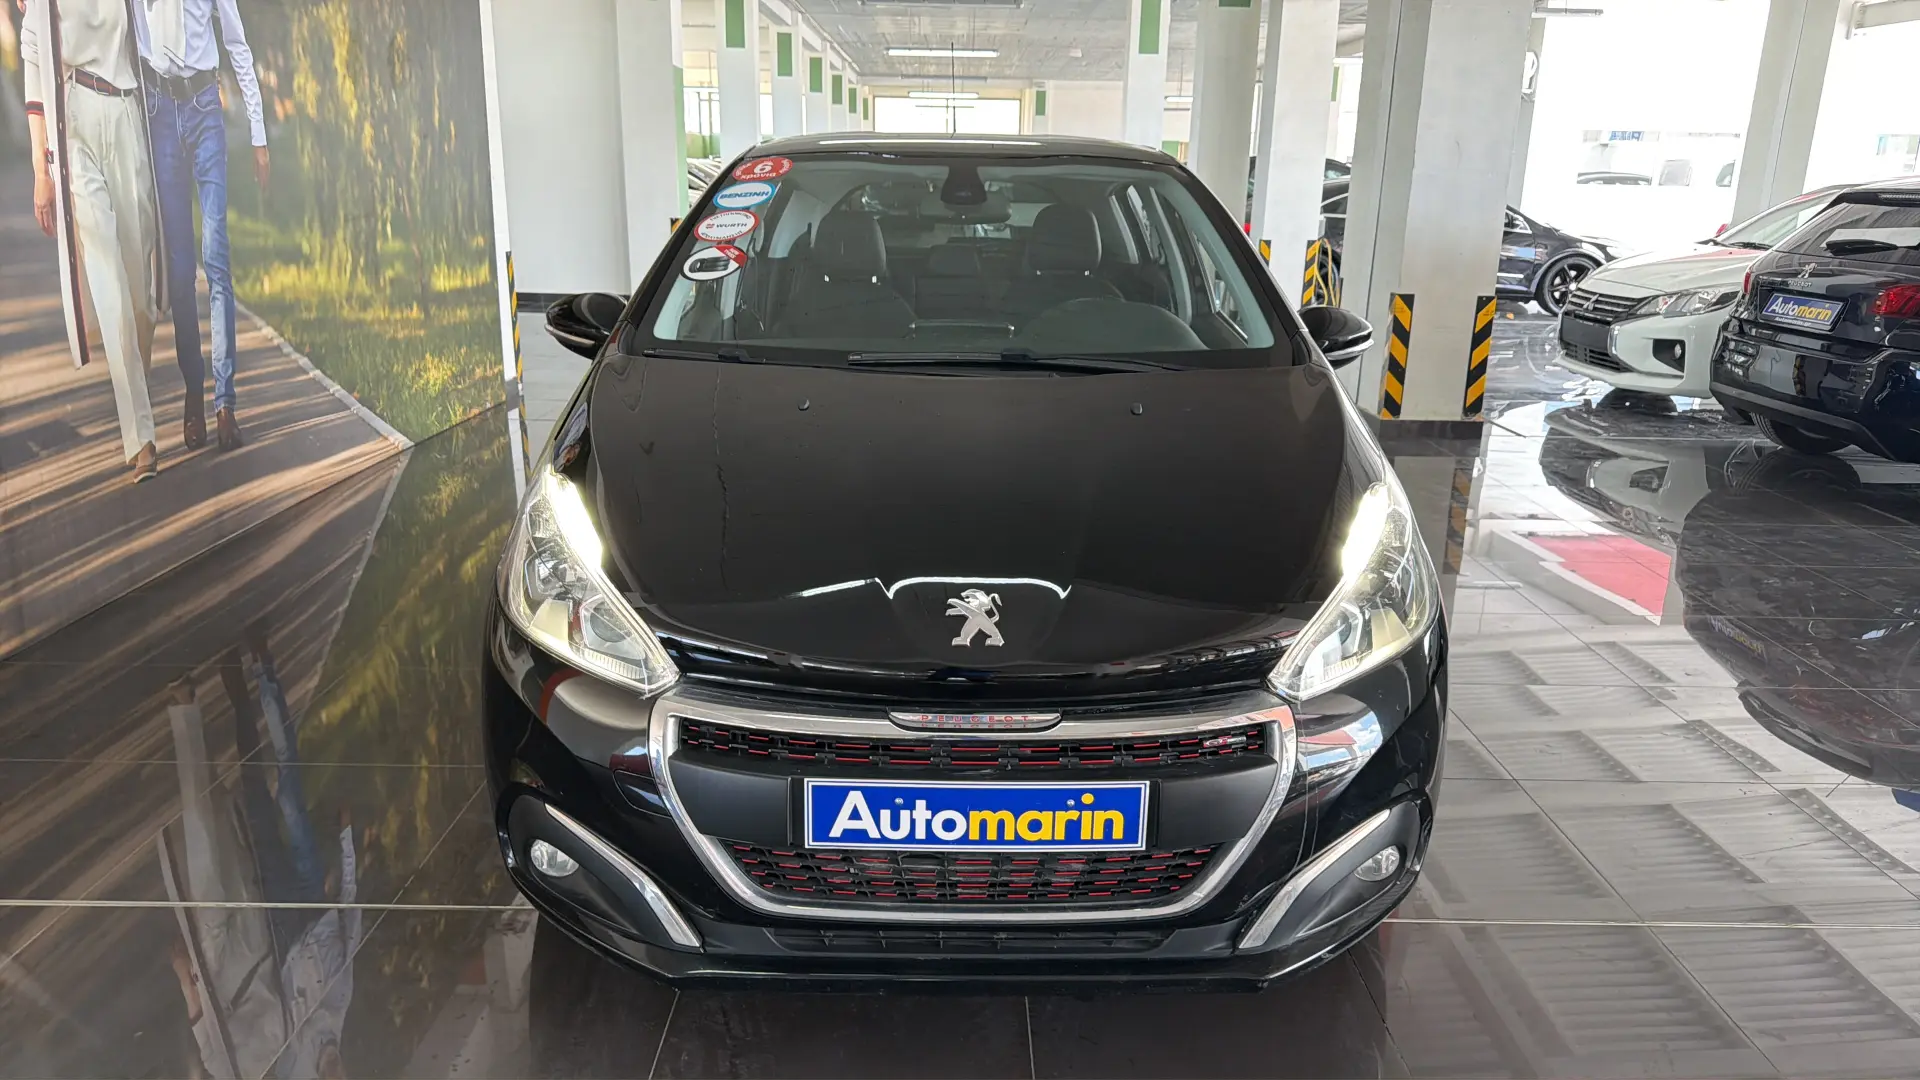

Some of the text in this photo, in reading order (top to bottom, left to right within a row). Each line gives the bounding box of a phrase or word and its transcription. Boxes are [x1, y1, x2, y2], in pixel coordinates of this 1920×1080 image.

[754, 161, 774, 173] 6
[1768, 297, 1832, 320] Automarin
[919, 713, 1030, 723] PEUGEOT
[828, 790, 1126, 841] Automarin
